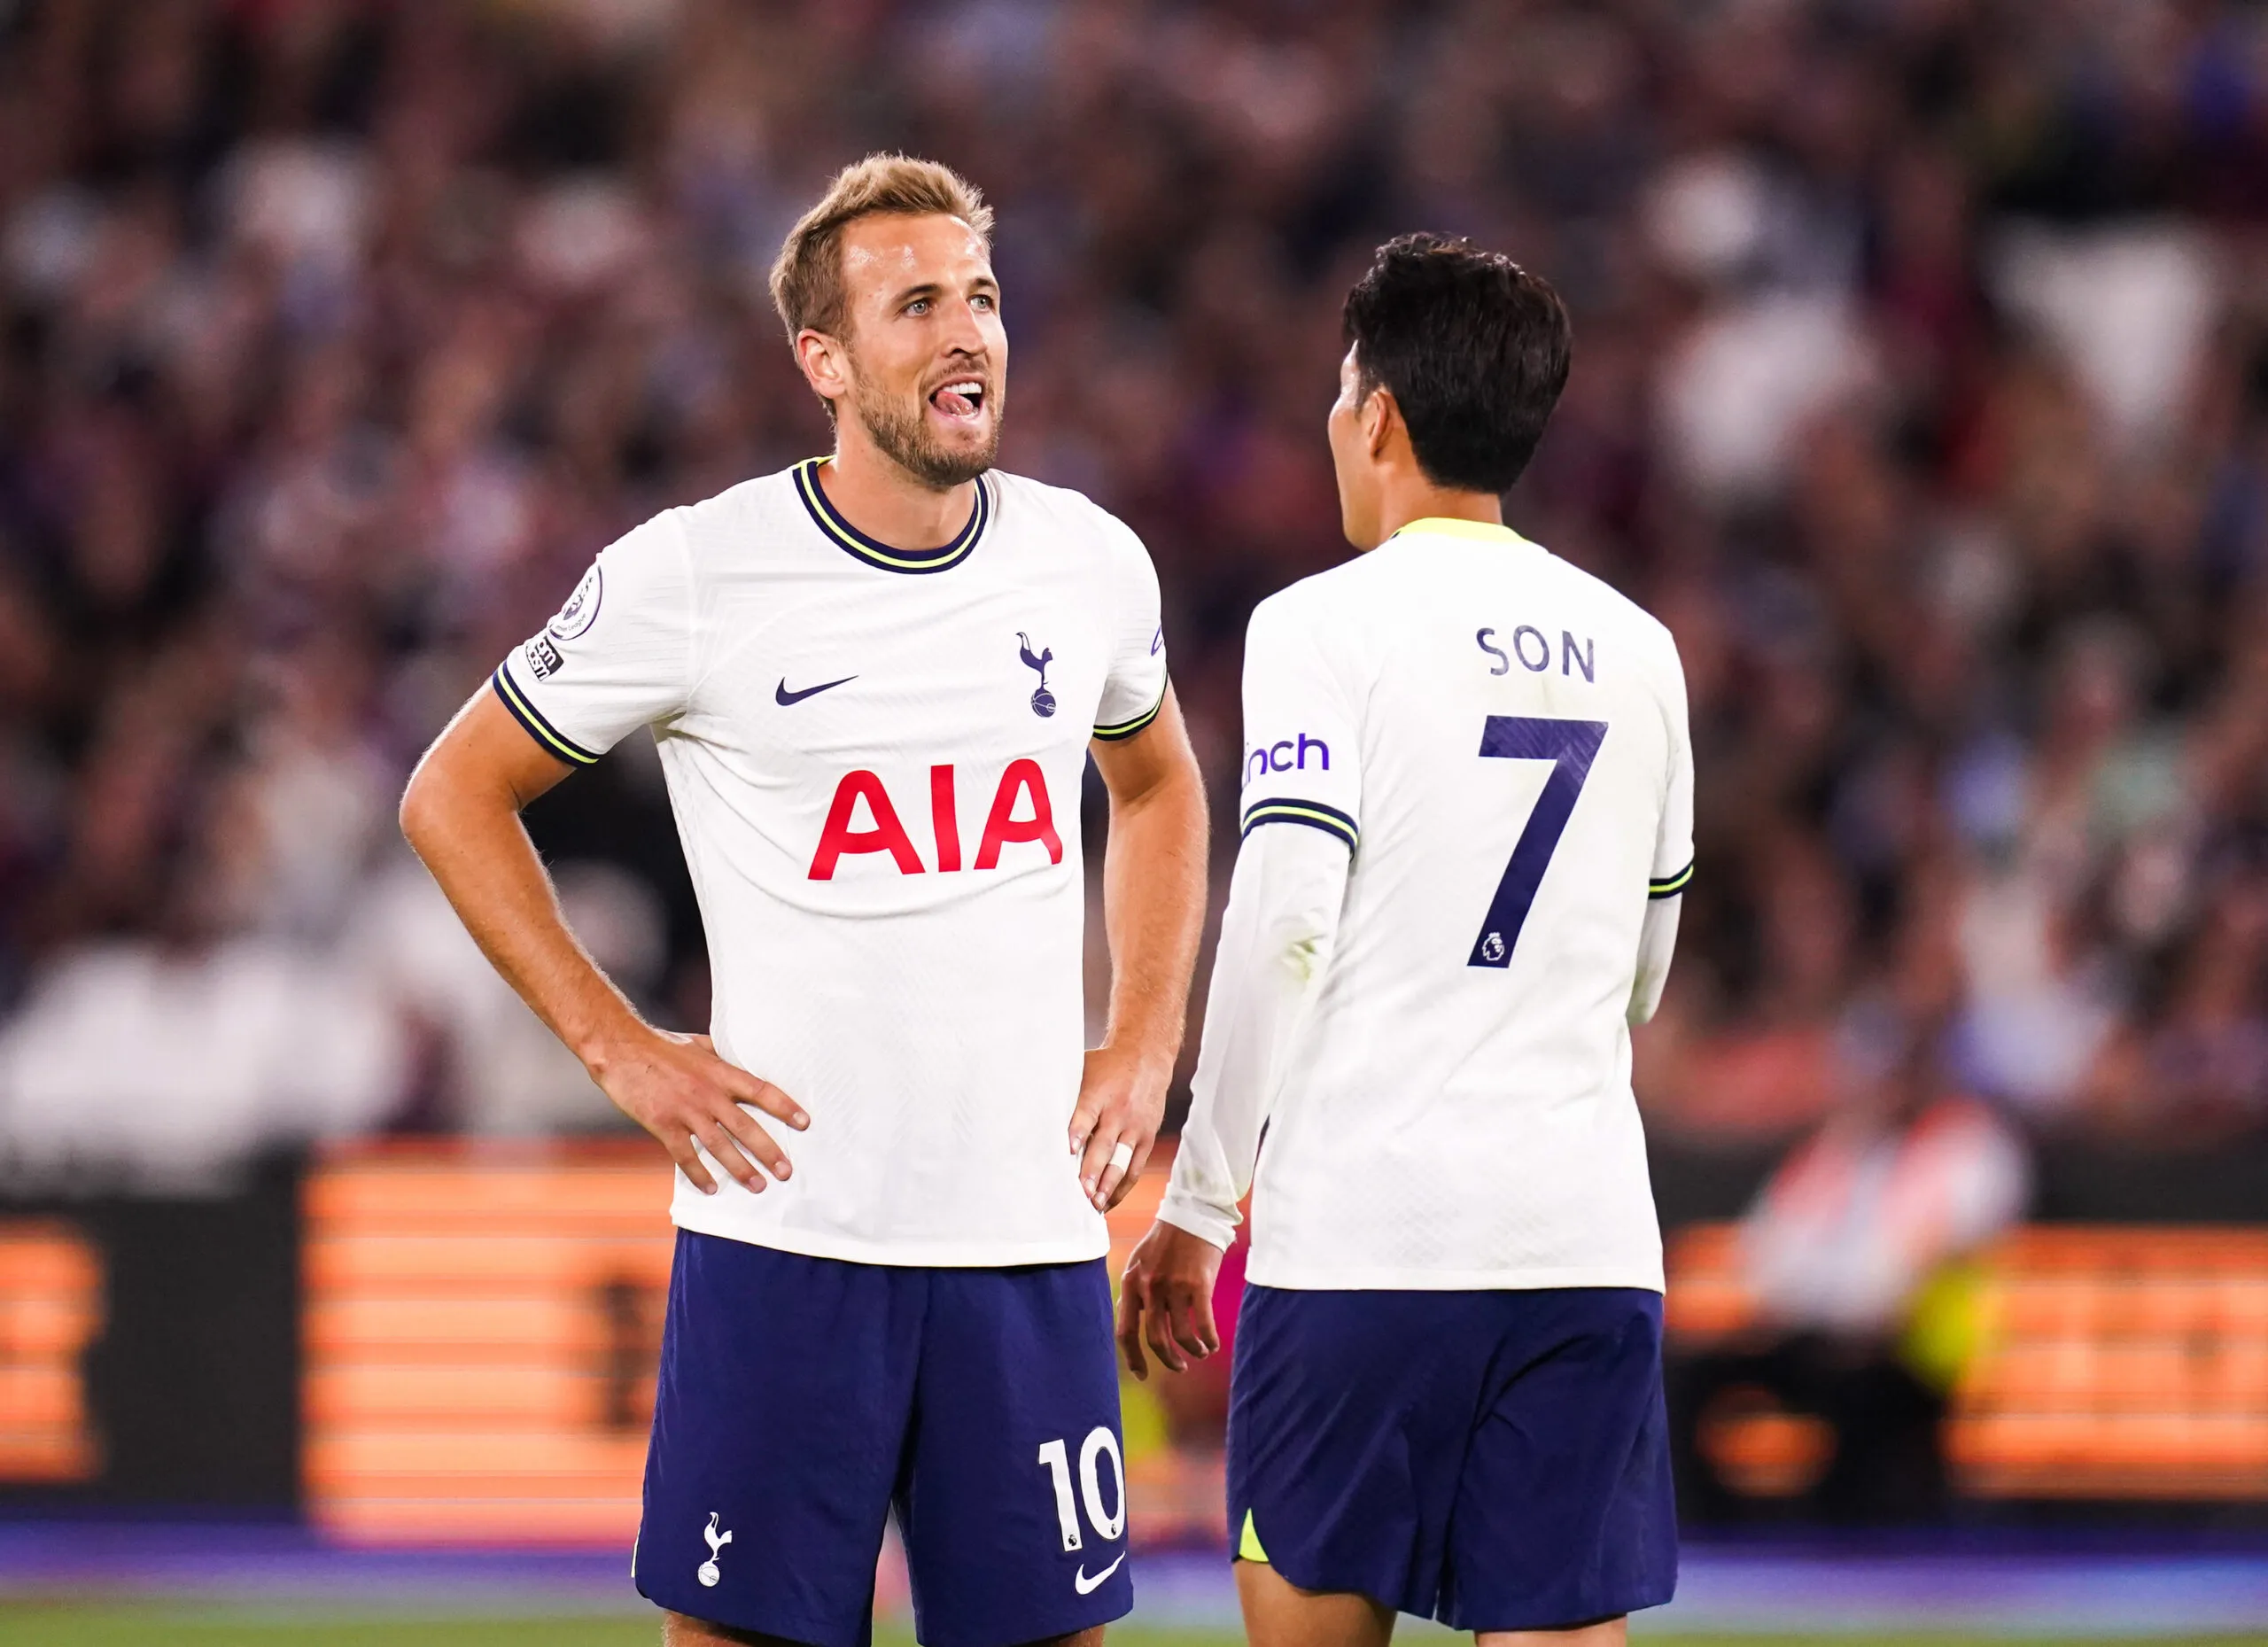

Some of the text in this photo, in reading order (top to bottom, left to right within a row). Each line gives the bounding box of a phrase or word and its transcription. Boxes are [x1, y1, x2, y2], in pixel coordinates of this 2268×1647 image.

[1476, 625, 1595, 683] SON
[807, 758, 1063, 880] AIA
[1467, 715, 1609, 968] 7
[1038, 1426, 1126, 1551] 10
